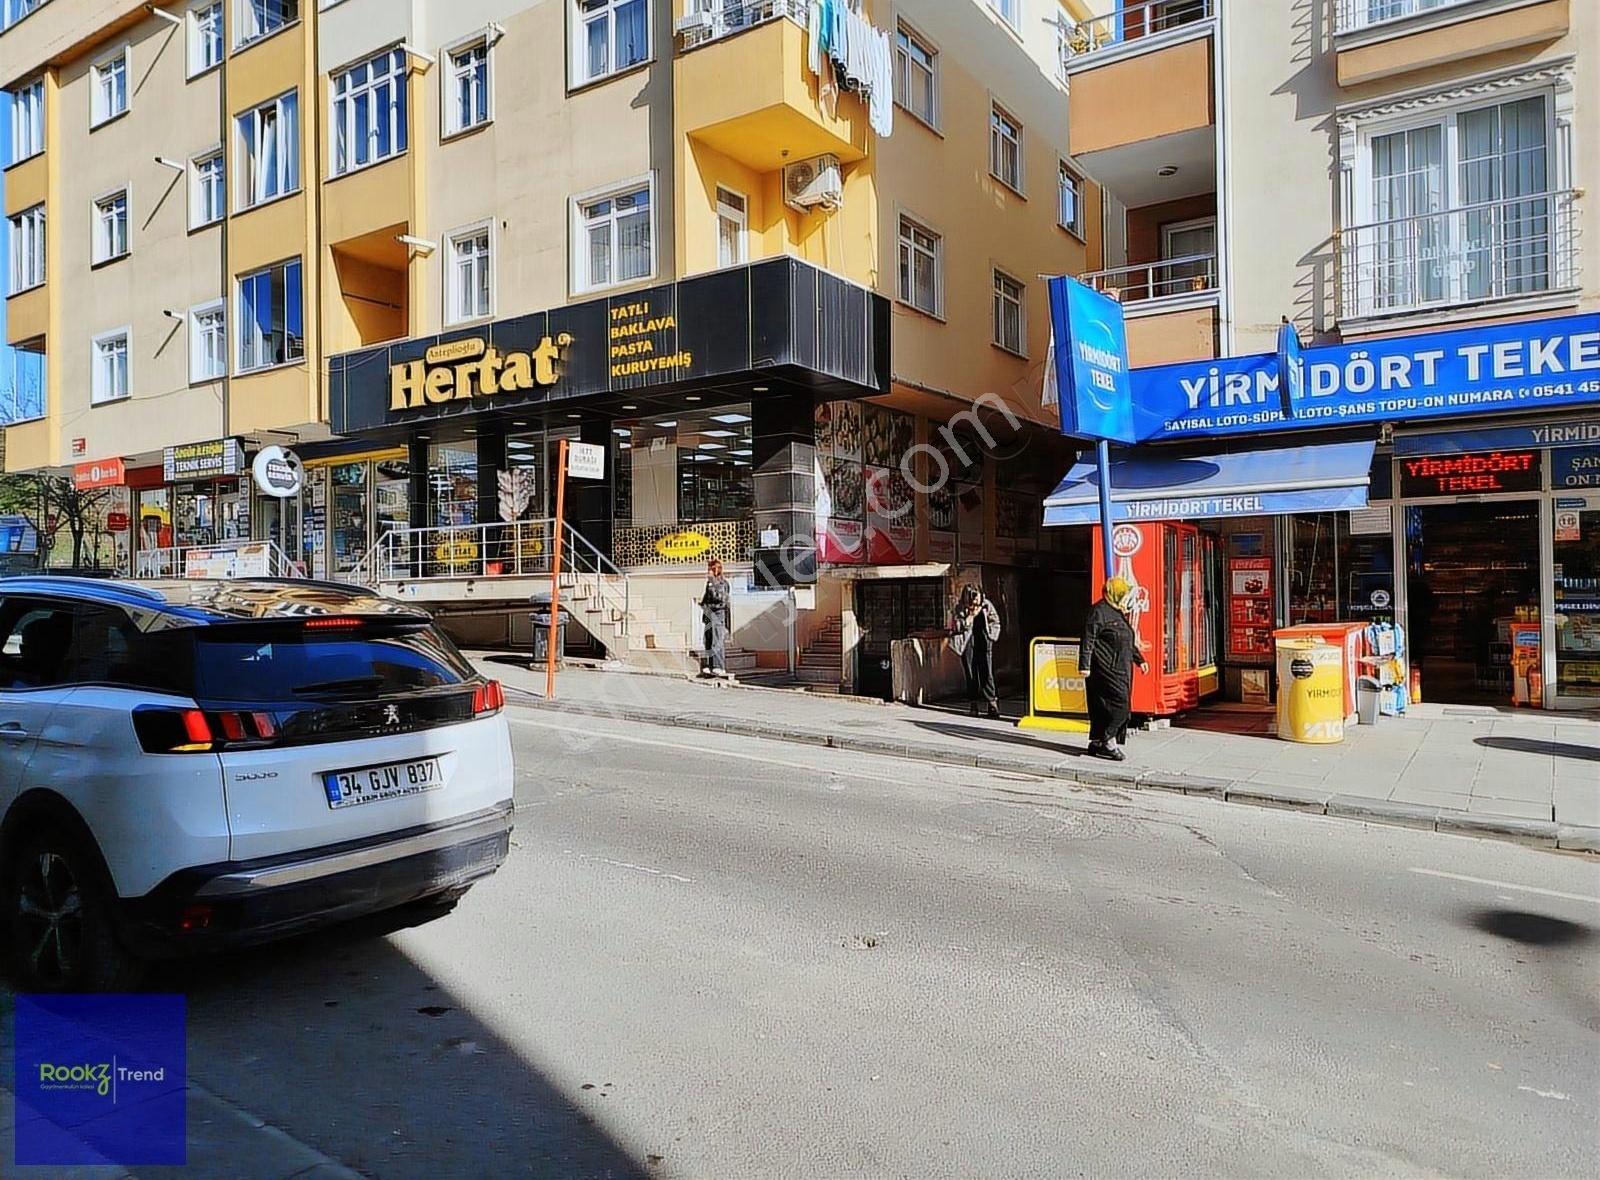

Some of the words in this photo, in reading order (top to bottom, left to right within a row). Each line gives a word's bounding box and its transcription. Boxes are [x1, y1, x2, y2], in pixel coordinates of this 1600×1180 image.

[611, 302, 649, 320] TATLI
[611, 316, 675, 339] BAKLAVA
[611, 340, 653, 358] PASTA
[390, 336, 559, 410] Hertat
[611, 351, 693, 377] KURUYEMİŞ
[1091, 368, 1116, 392] TEKEL
[1164, 419, 1213, 432] SAYISAL
[1216, 409, 1290, 427] LOTO-SÜPE
[1379, 395, 1444, 413] TOPU-ON
[1448, 389, 1514, 406] NUMARA
[1533, 382, 1574, 398] 0541
[1406, 452, 1533, 477] YİRMİDÖRT
[1438, 475, 1503, 492] TEKEL
[1127, 501, 1210, 518] YİRMİDÖRT
[1212, 496, 1264, 512] TEKEL
[340, 774, 361, 797] 34
[369, 766, 399, 791] GJV
[407, 762, 433, 784] 837
